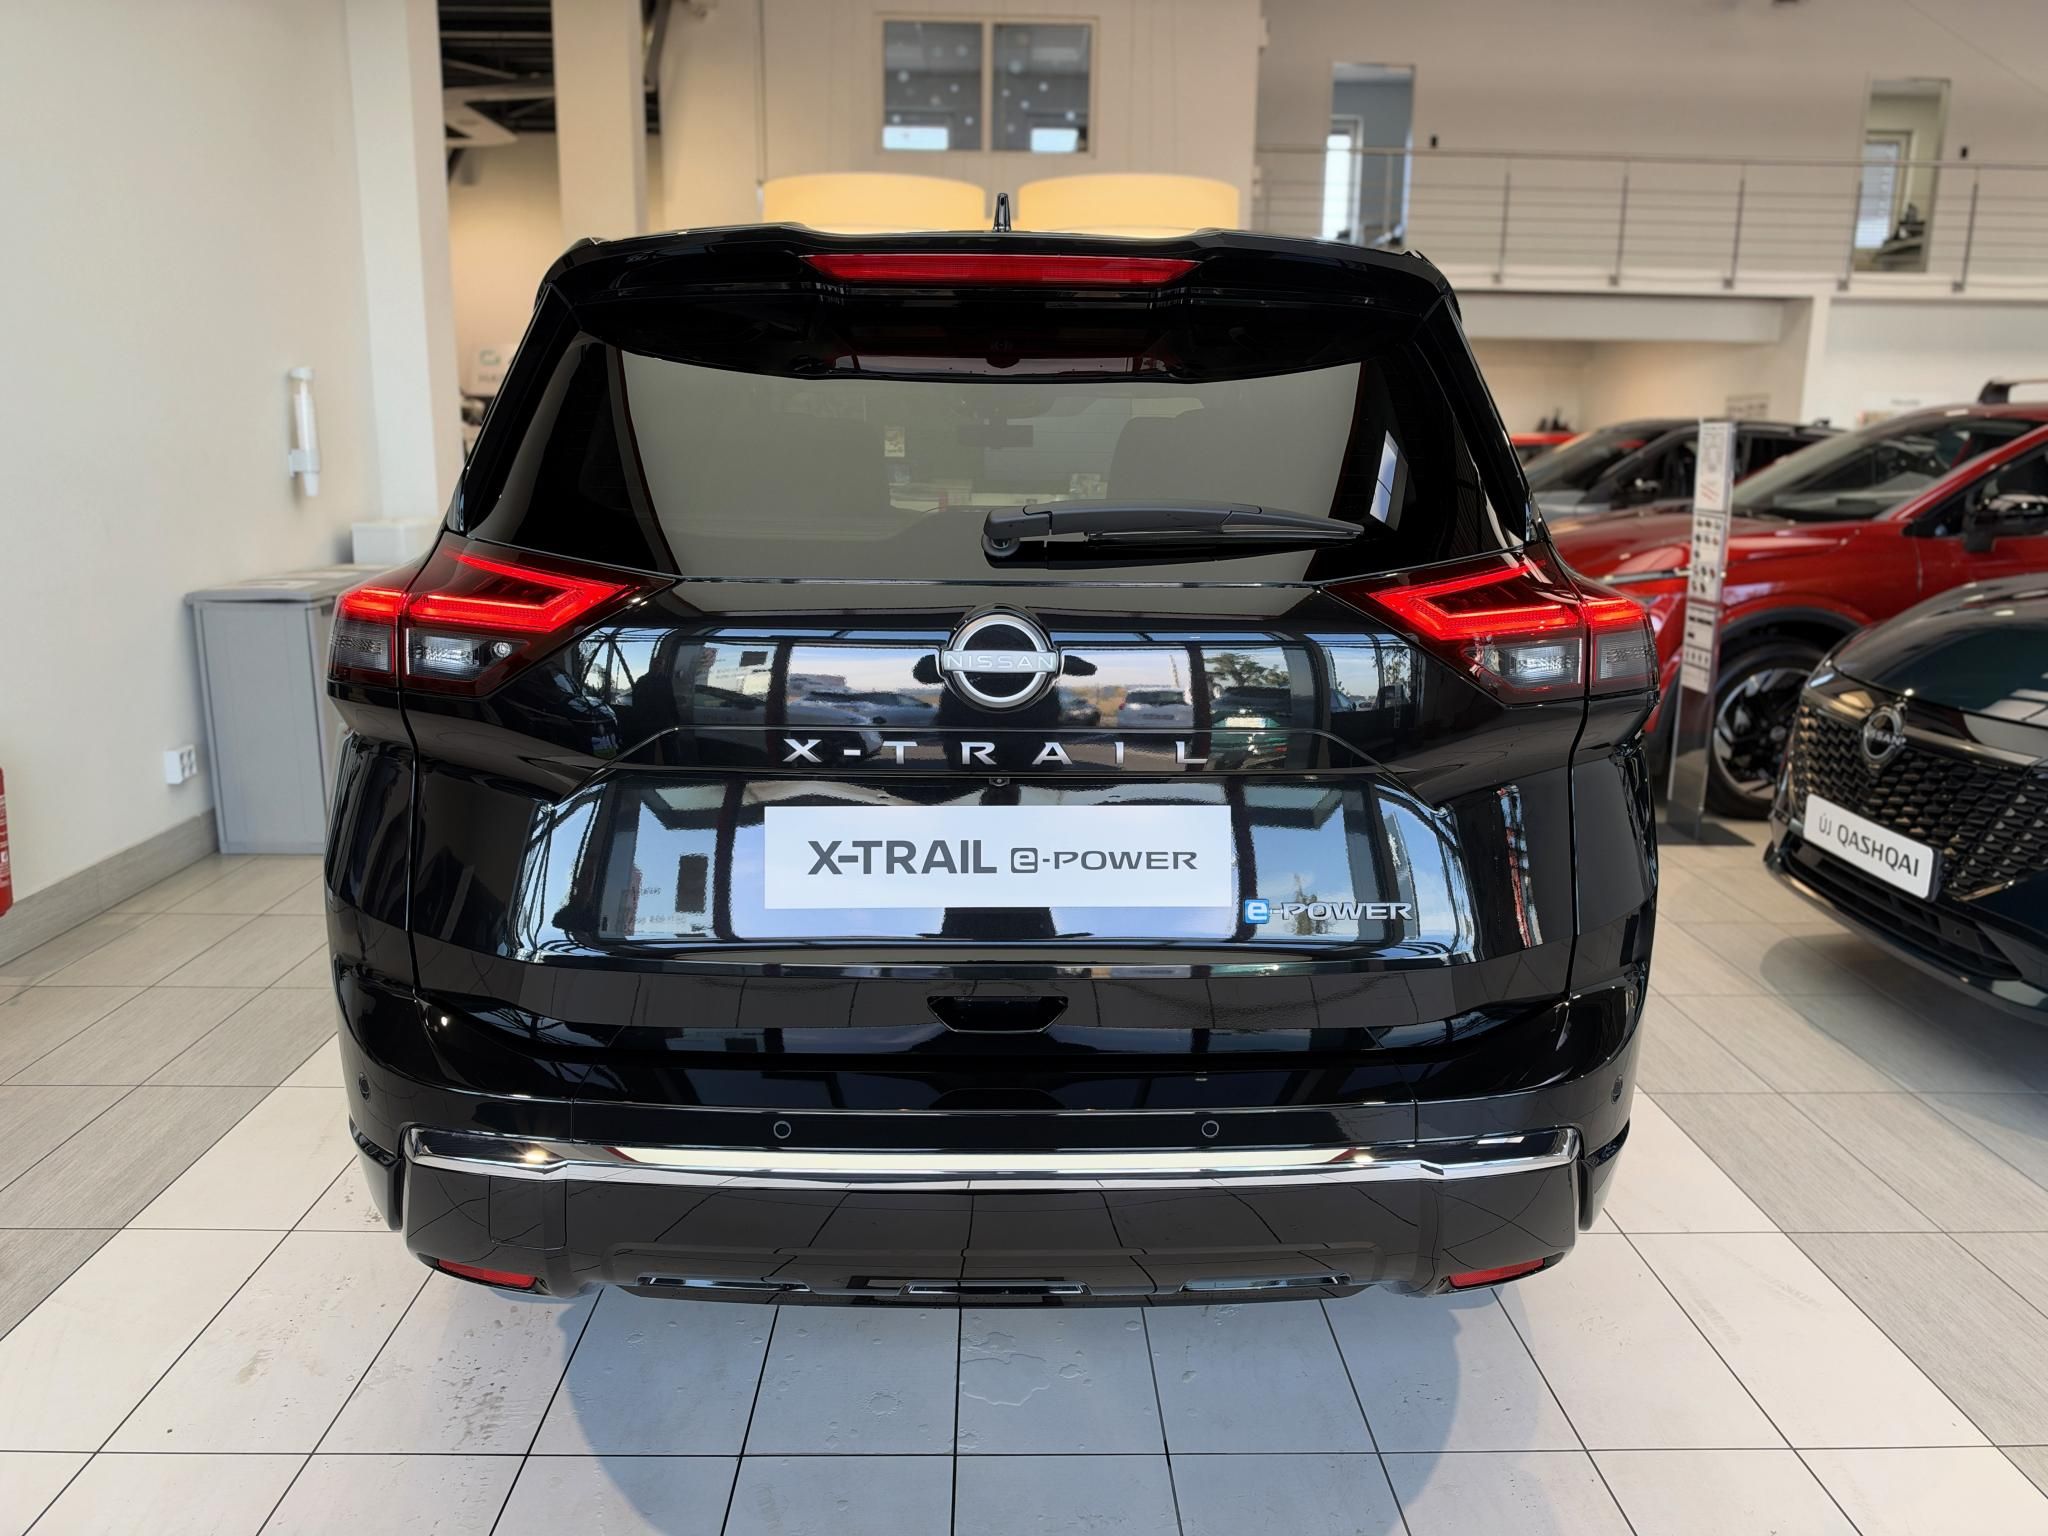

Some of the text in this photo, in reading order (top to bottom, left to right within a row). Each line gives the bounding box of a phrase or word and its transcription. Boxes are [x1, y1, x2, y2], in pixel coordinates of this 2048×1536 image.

[946, 654, 1054, 670] NISSAN
[782, 738, 1209, 765] X-TRAIL
[807, 839, 1199, 876] X-TRAIL e-POWER
[1837, 823, 1920, 878] QASHQAI
[1243, 898, 1414, 925] e-POWER
